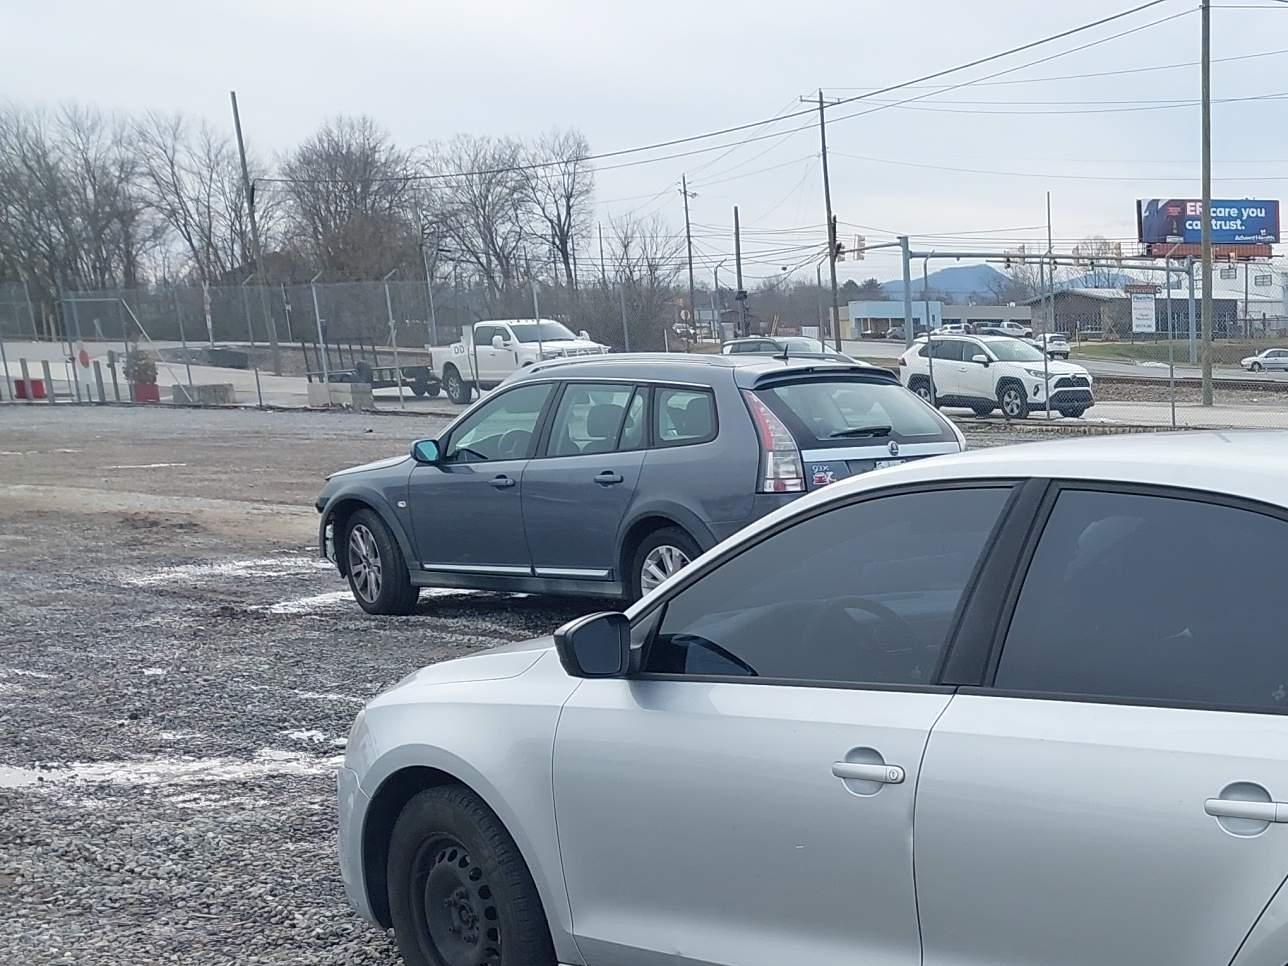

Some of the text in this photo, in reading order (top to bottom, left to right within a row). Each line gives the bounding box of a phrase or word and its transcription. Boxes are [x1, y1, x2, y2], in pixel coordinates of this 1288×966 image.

[1210, 207, 1238, 218] care
[1241, 207, 1265, 221] you
[1185, 219, 1245, 230] ca trust.
